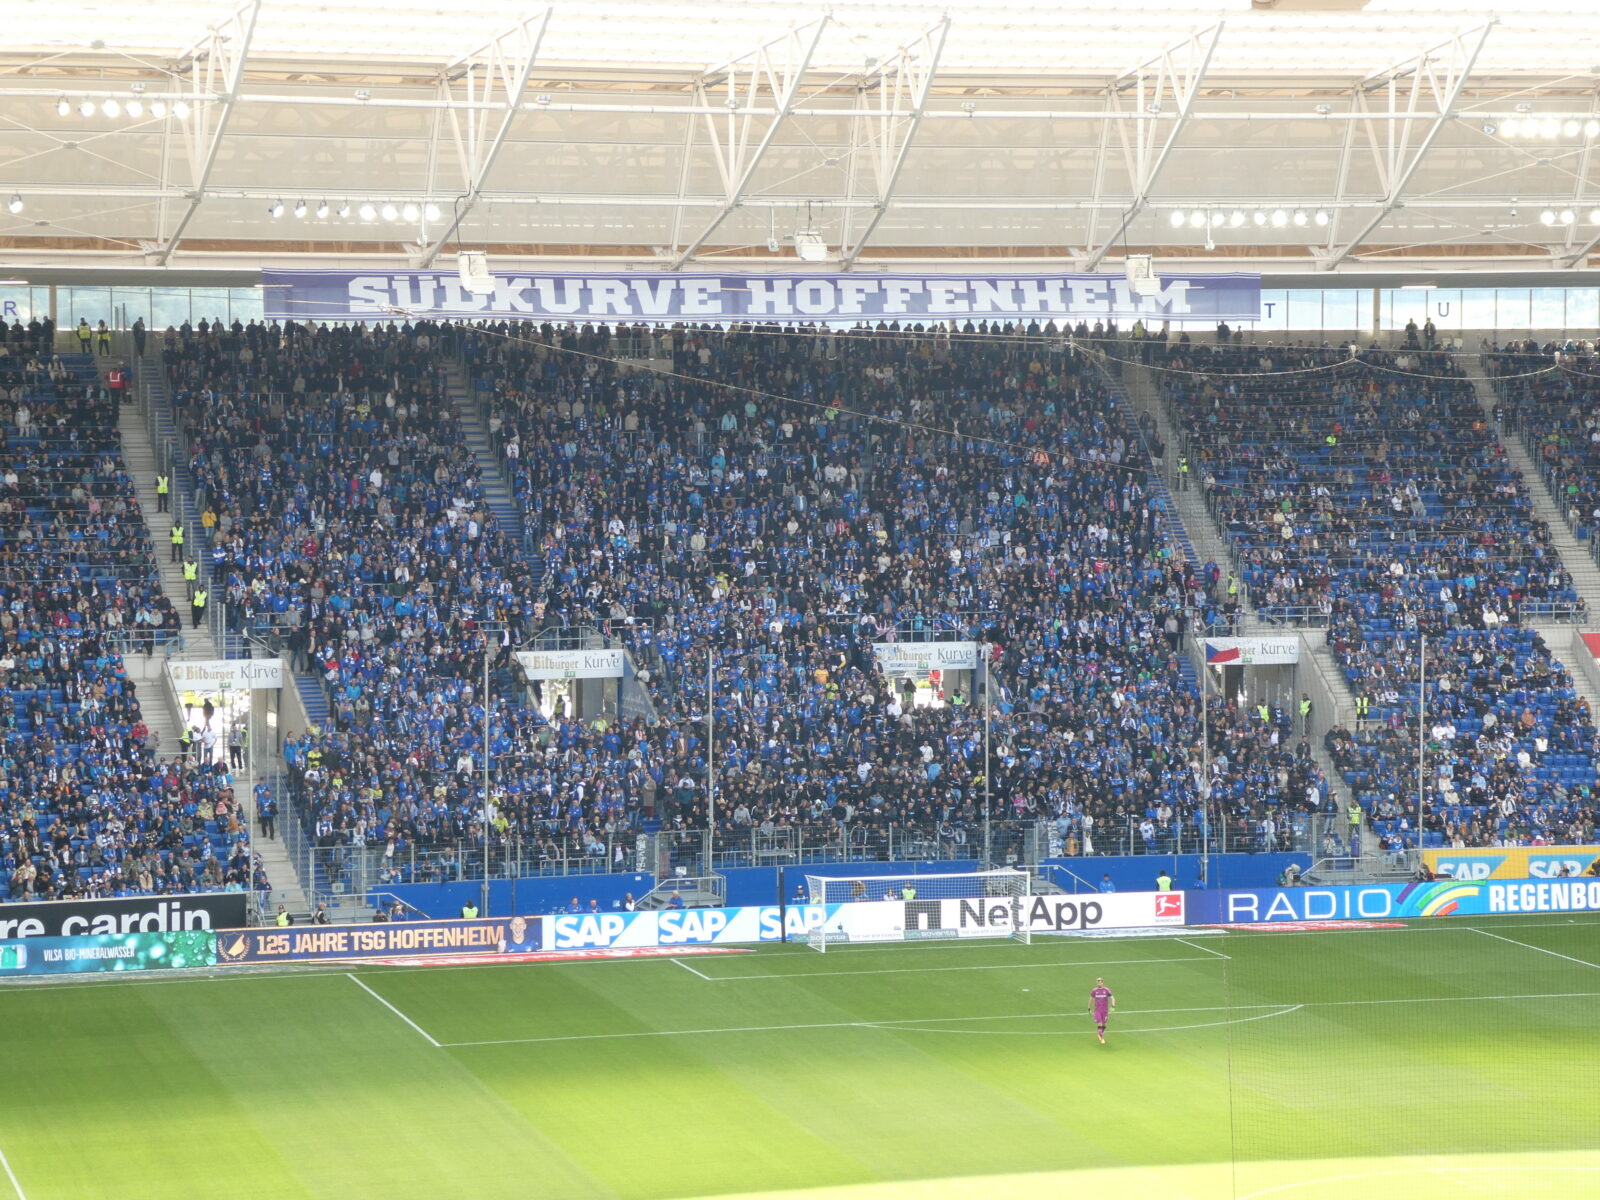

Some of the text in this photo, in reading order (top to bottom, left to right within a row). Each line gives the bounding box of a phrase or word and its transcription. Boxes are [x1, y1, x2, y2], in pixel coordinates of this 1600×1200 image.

[347, 275, 1192, 316] SÜDKURVE HOFFENHEIM
[4, 301, 17, 316] R
[1264, 303, 1276, 318] T
[1438, 302, 1450, 317] U
[937, 648, 972, 660] Kurve
[1261, 643, 1295, 655] Kurve
[533, 655, 579, 670] Bitburger
[584, 656, 619, 669] Kurve
[185, 665, 278, 681] Bitburger Kurve
[1437, 860, 1582, 880] SAP SAP
[1228, 881, 1600, 922] RADIO REGENBO
[61, 902, 210, 936] cardin
[760, 905, 827, 940] SAP
[959, 896, 1103, 931] NetApp
[555, 914, 625, 948] SAP
[658, 910, 727, 943] SAP
[257, 925, 505, 955] 125 JAHRE TSG HOFFENHEIM
[43, 945, 135, 962] VILSA BIO-MINERALWASSER
